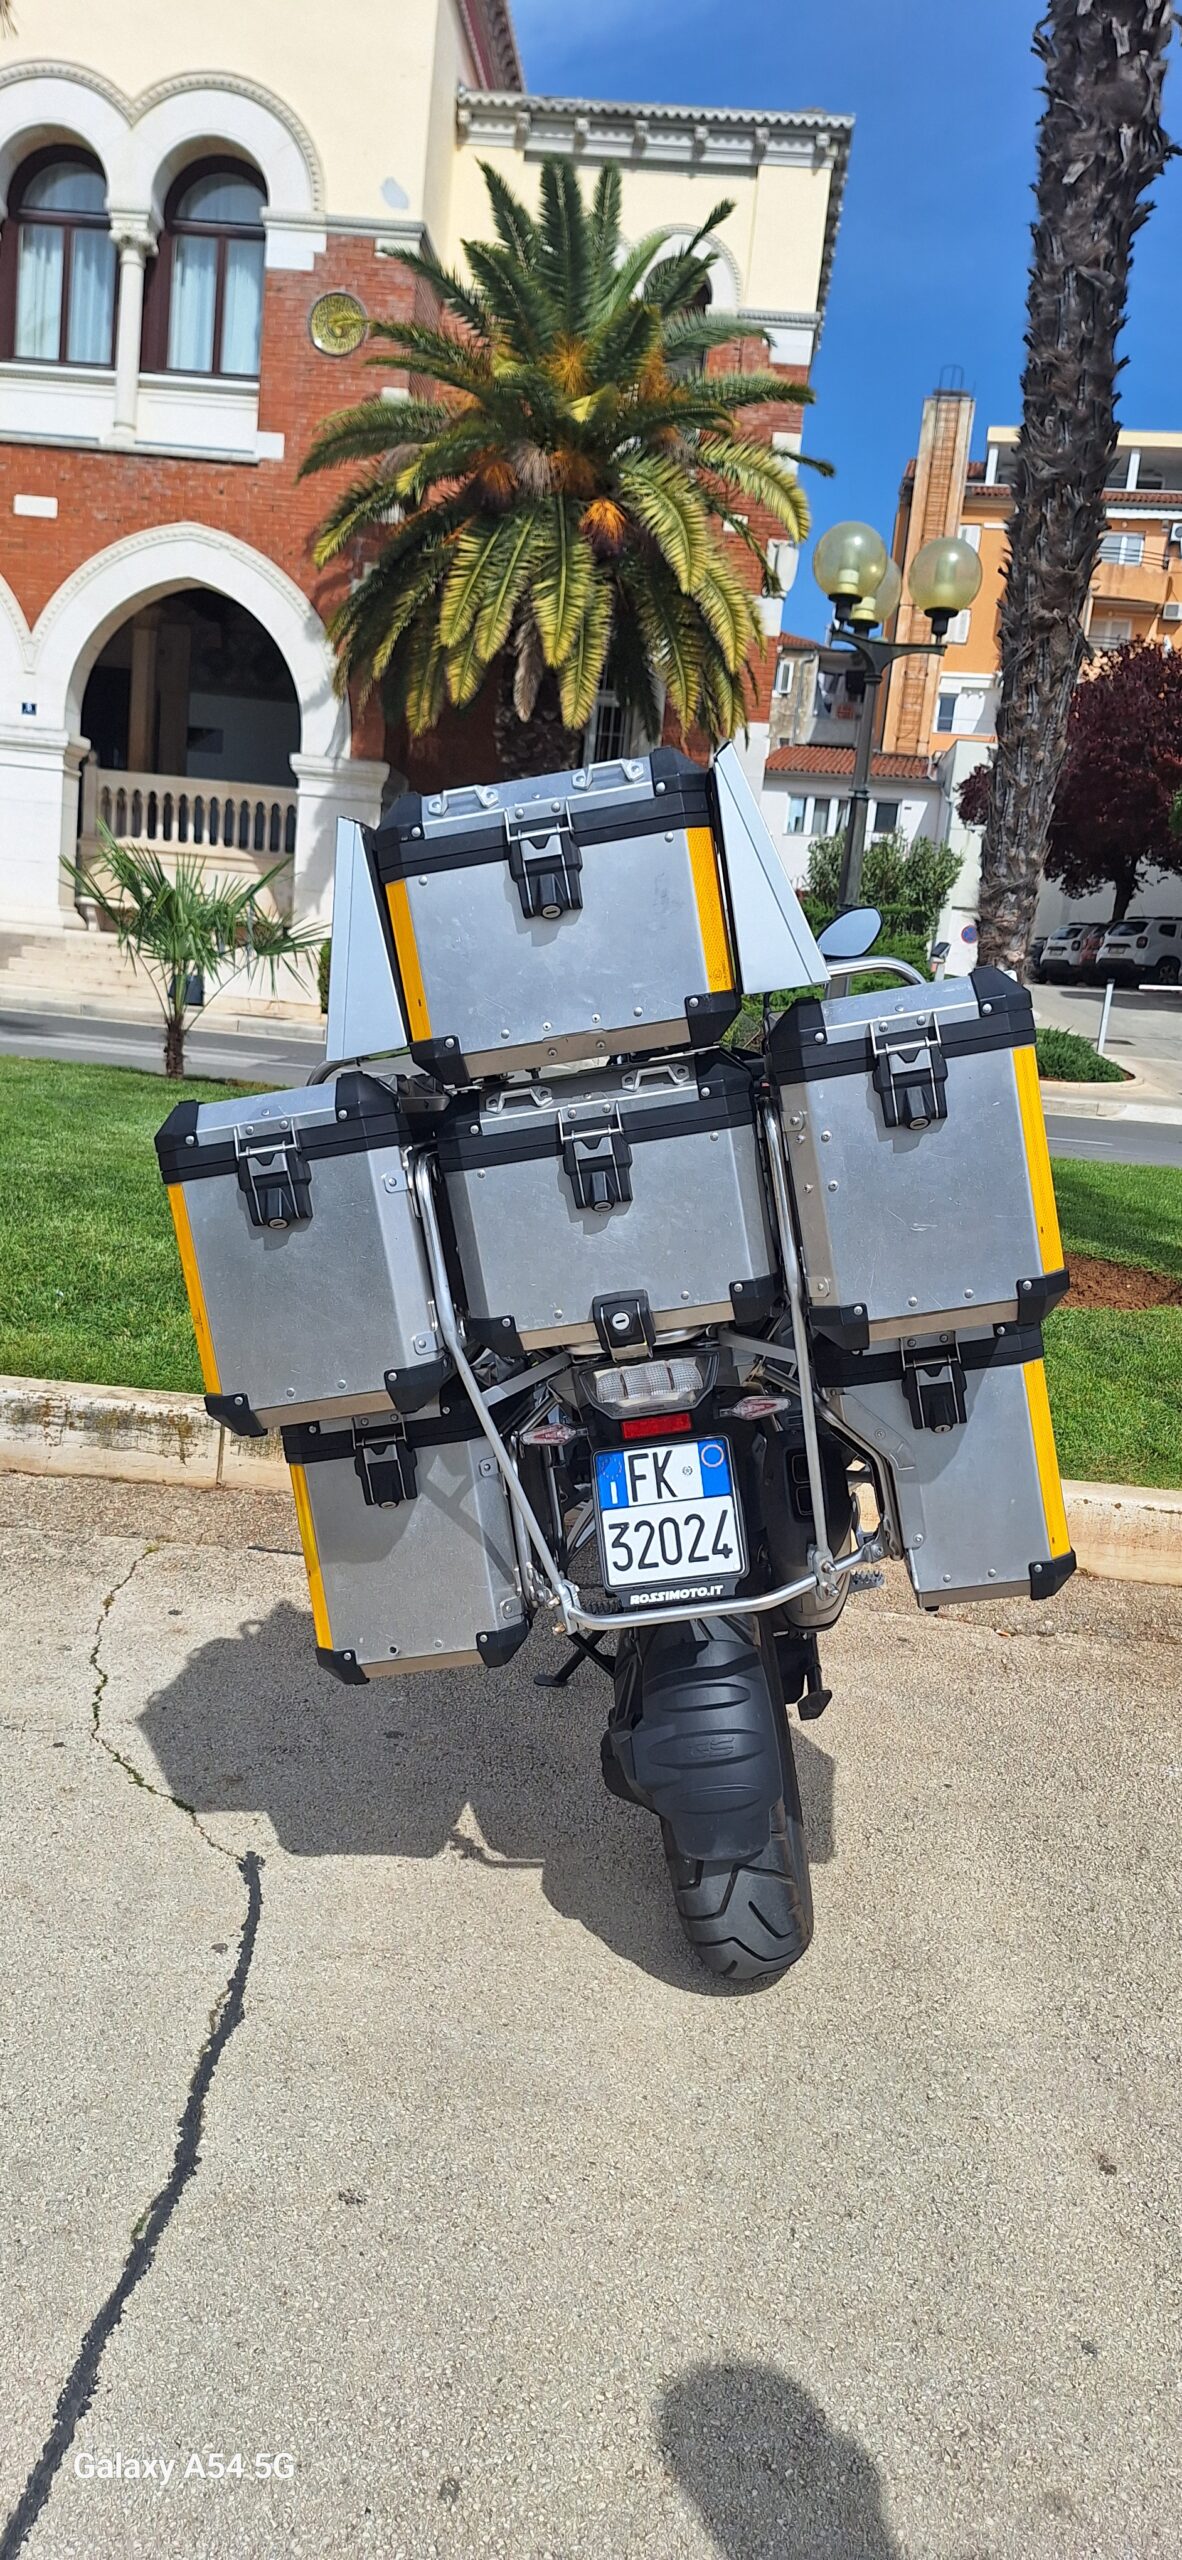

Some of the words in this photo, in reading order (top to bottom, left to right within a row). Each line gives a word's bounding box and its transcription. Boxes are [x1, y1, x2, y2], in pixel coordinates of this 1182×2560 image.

[628, 1450, 678, 1502] FK
[608, 1509, 733, 1571] 32024
[630, 1585, 724, 1605] ROSSIMOTO.IT
